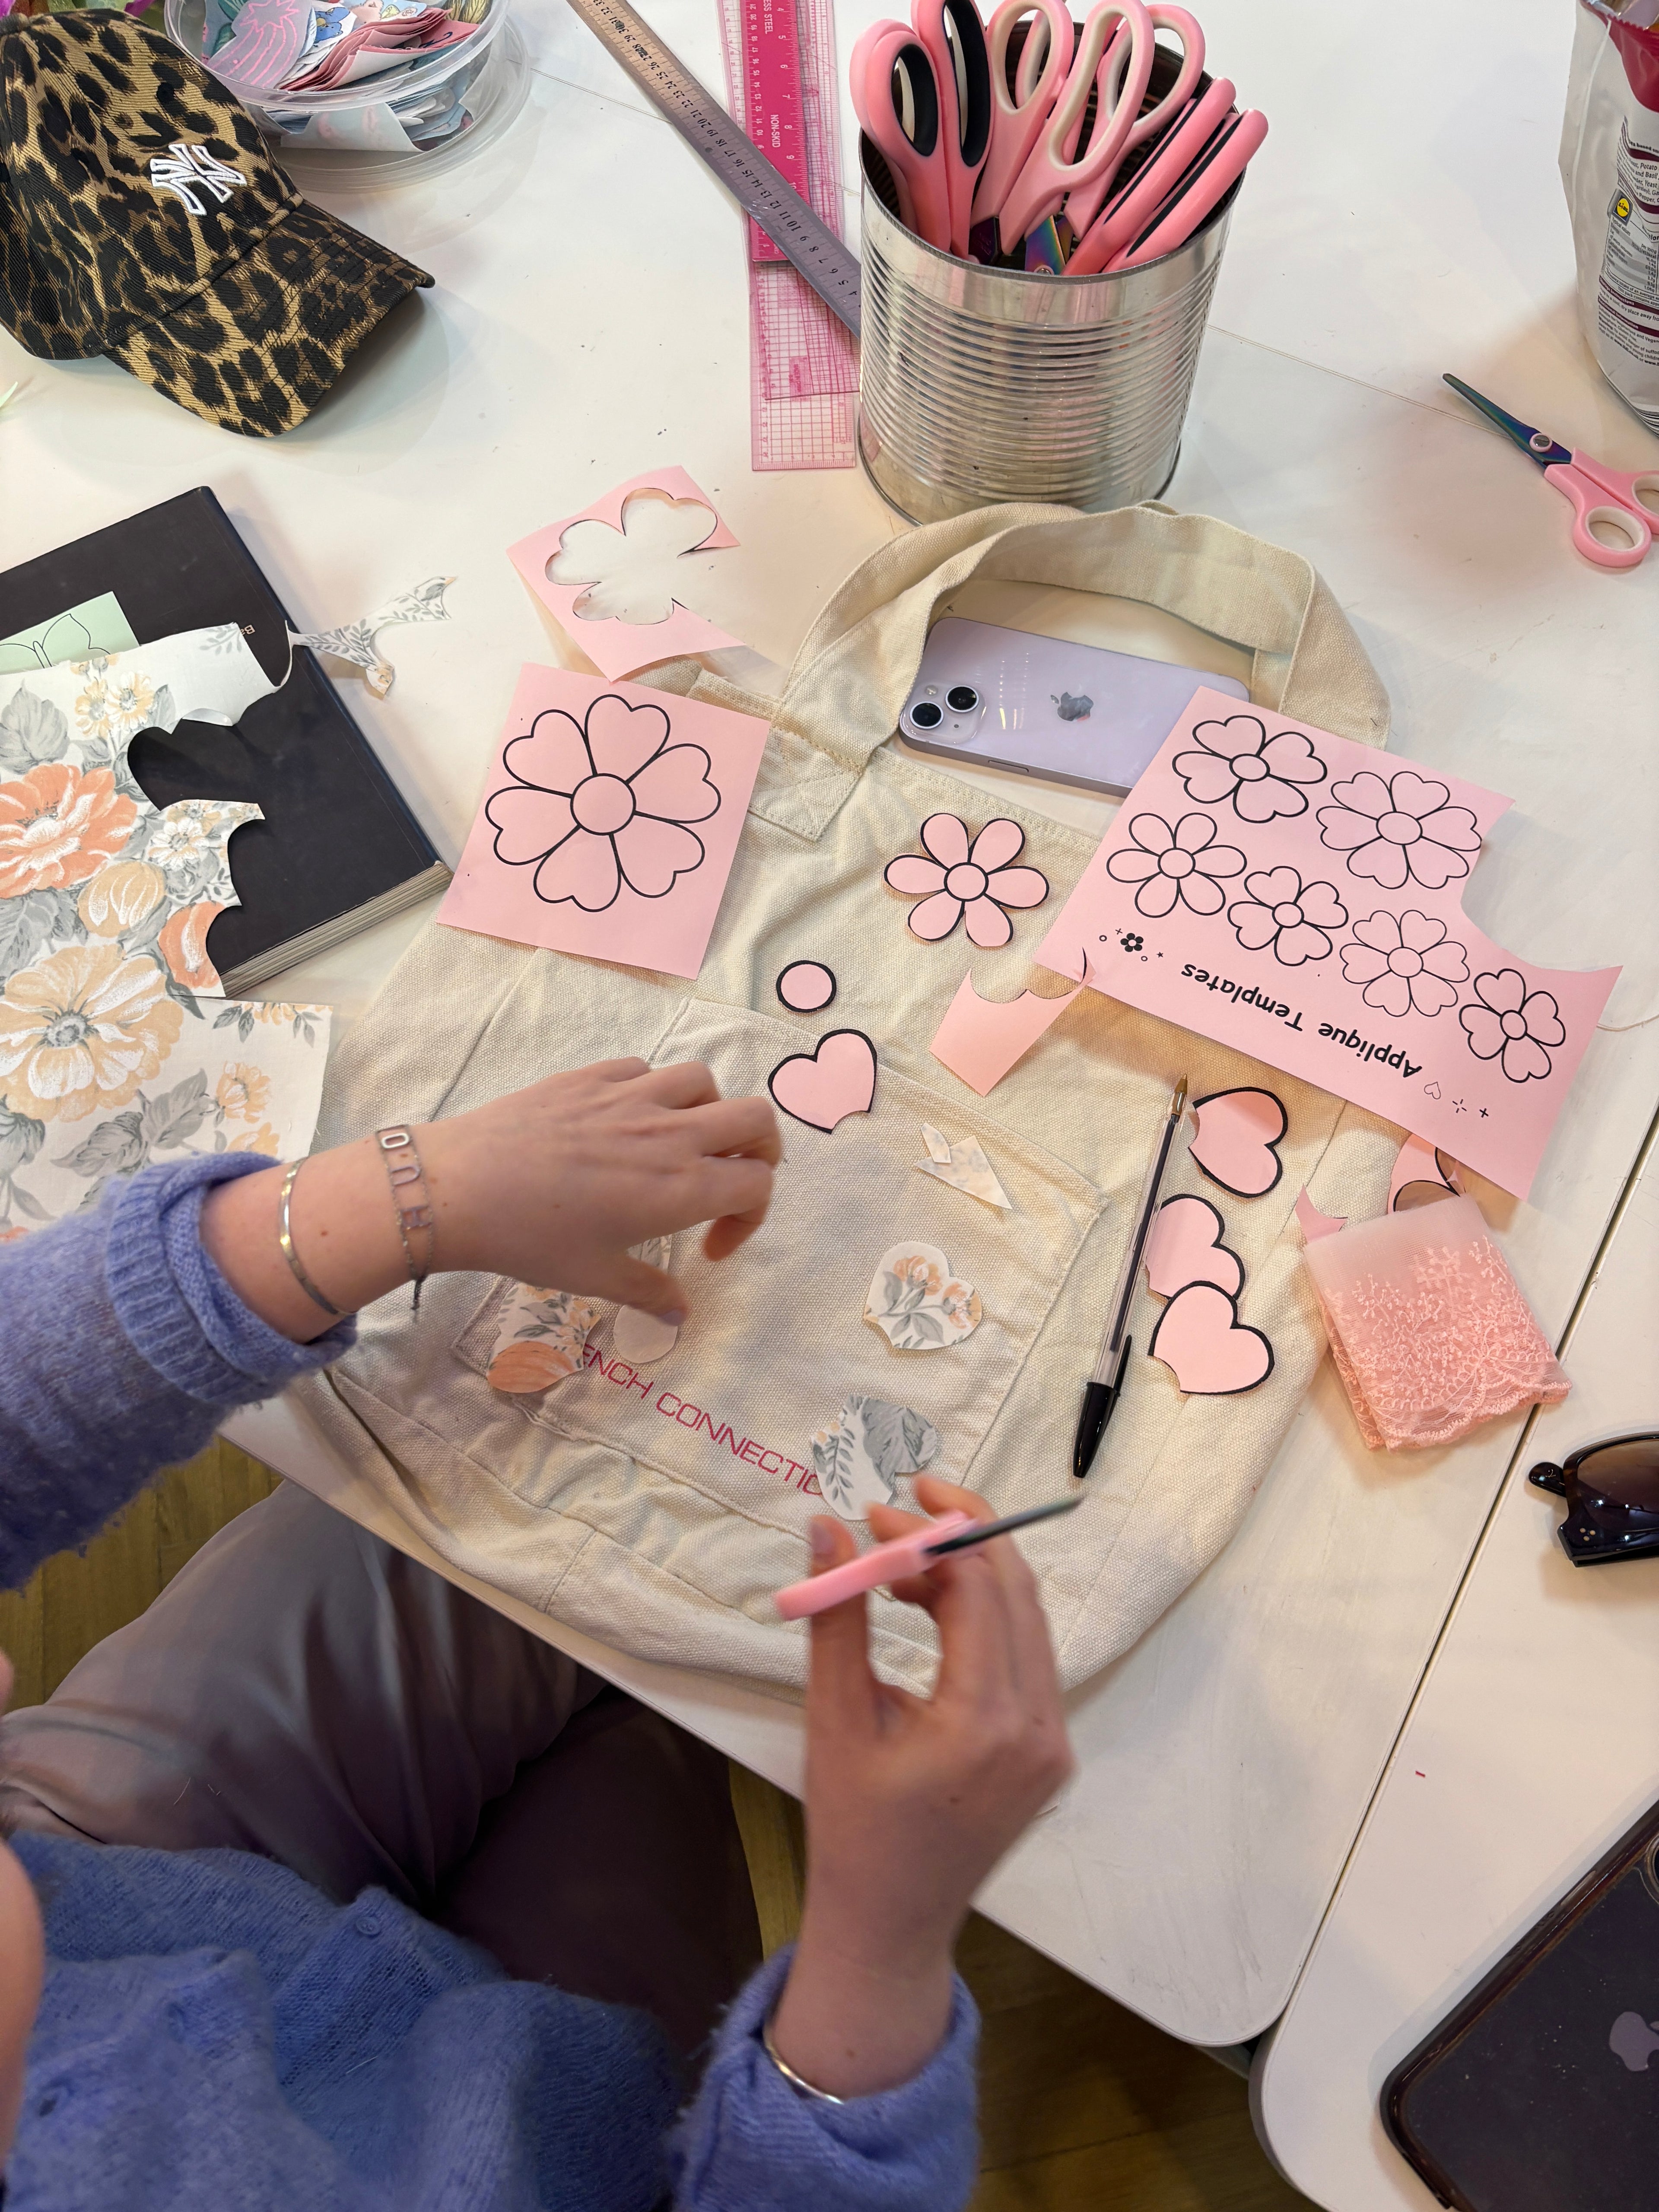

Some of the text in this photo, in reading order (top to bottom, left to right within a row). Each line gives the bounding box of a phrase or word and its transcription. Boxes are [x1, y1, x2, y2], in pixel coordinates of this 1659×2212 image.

[764, 14, 773, 34] STEEL
[648, 62, 660, 70] 26
[656, 71, 669, 79] 25
[665, 81, 677, 89] 24
[673, 90, 685, 99] 23
[681, 99, 693, 108] 22
[690, 110, 702, 118] 21
[697, 118, 712, 128] 20
[770, 114, 781, 148] NON-SKID
[715, 139, 727, 147] 18
[733, 159, 745, 167] 16
[1640, 162, 1658, 171] Potato
[742, 169, 754, 178] 15
[150, 143, 247, 216] NY
[751, 179, 763, 188] 14
[760, 190, 772, 198] 13
[770, 200, 782, 209] 12
[779, 211, 791, 219] 11
[786, 220, 802, 231] 10
[1181, 963, 1423, 1078] Applique Templates
